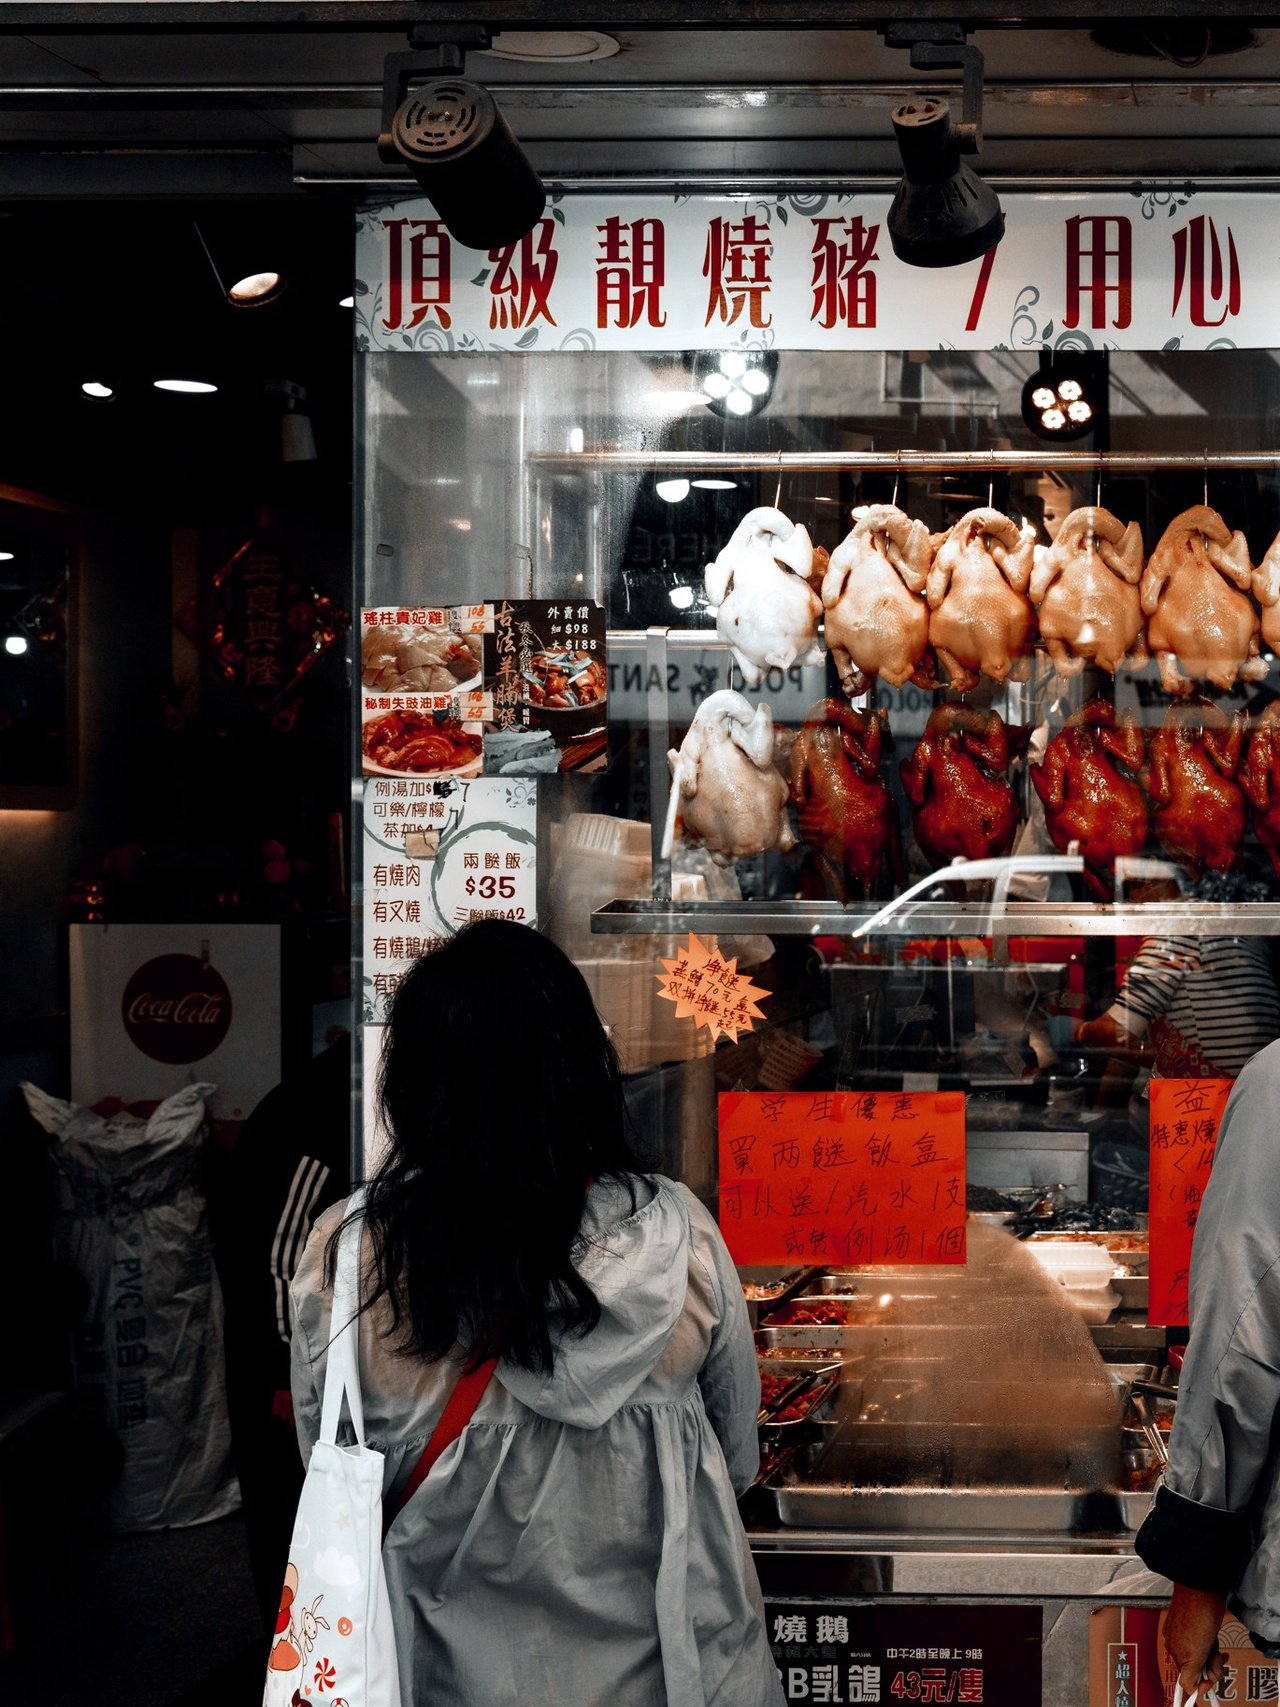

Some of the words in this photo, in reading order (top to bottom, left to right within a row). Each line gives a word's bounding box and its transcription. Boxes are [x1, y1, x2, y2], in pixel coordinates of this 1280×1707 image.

[547, 606, 590, 619] 外賣價
[565, 623, 588, 634] $98
[552, 640, 562, 651] 大
[565, 639, 597, 650] $188
[373, 802, 445, 818] 可樂/檸檬
[463, 852, 521, 869] 兩餸飯
[373, 864, 421, 887] 有燒肉
[465, 875, 516, 899] $35
[373, 900, 421, 923] 有叉燒
[773, 1615, 850, 1644] 燒鵝
[777, 1665, 881, 1703] B乳鴿
[890, 1668, 984, 1703] 43元/隻
